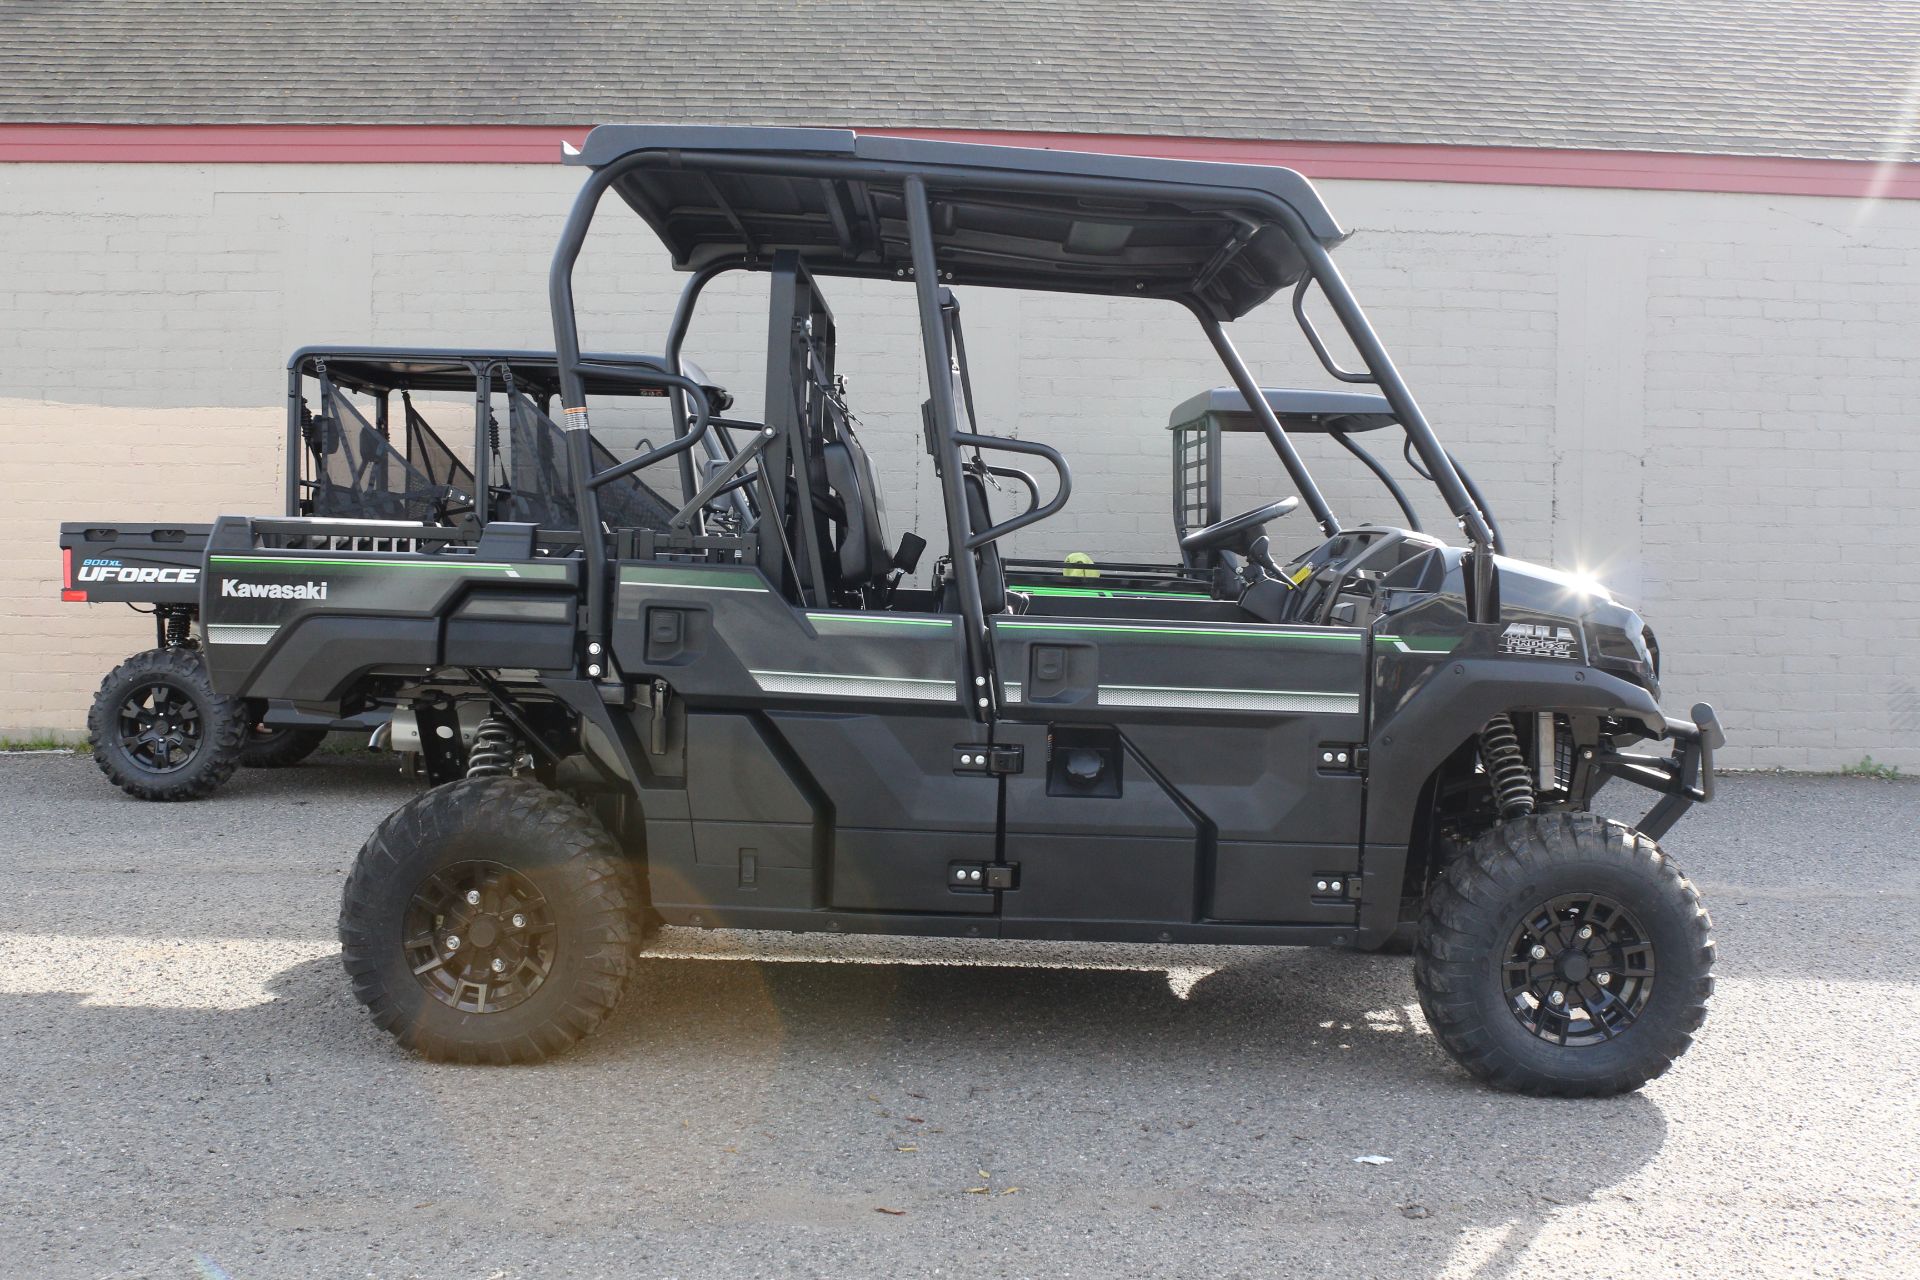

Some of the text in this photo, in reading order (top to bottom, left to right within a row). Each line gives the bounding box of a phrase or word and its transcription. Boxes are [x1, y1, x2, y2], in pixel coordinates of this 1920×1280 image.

[77, 566, 200, 583] UFORCE
[221, 579, 328, 600] Kawasaki
[1500, 622, 1577, 644] MULE
